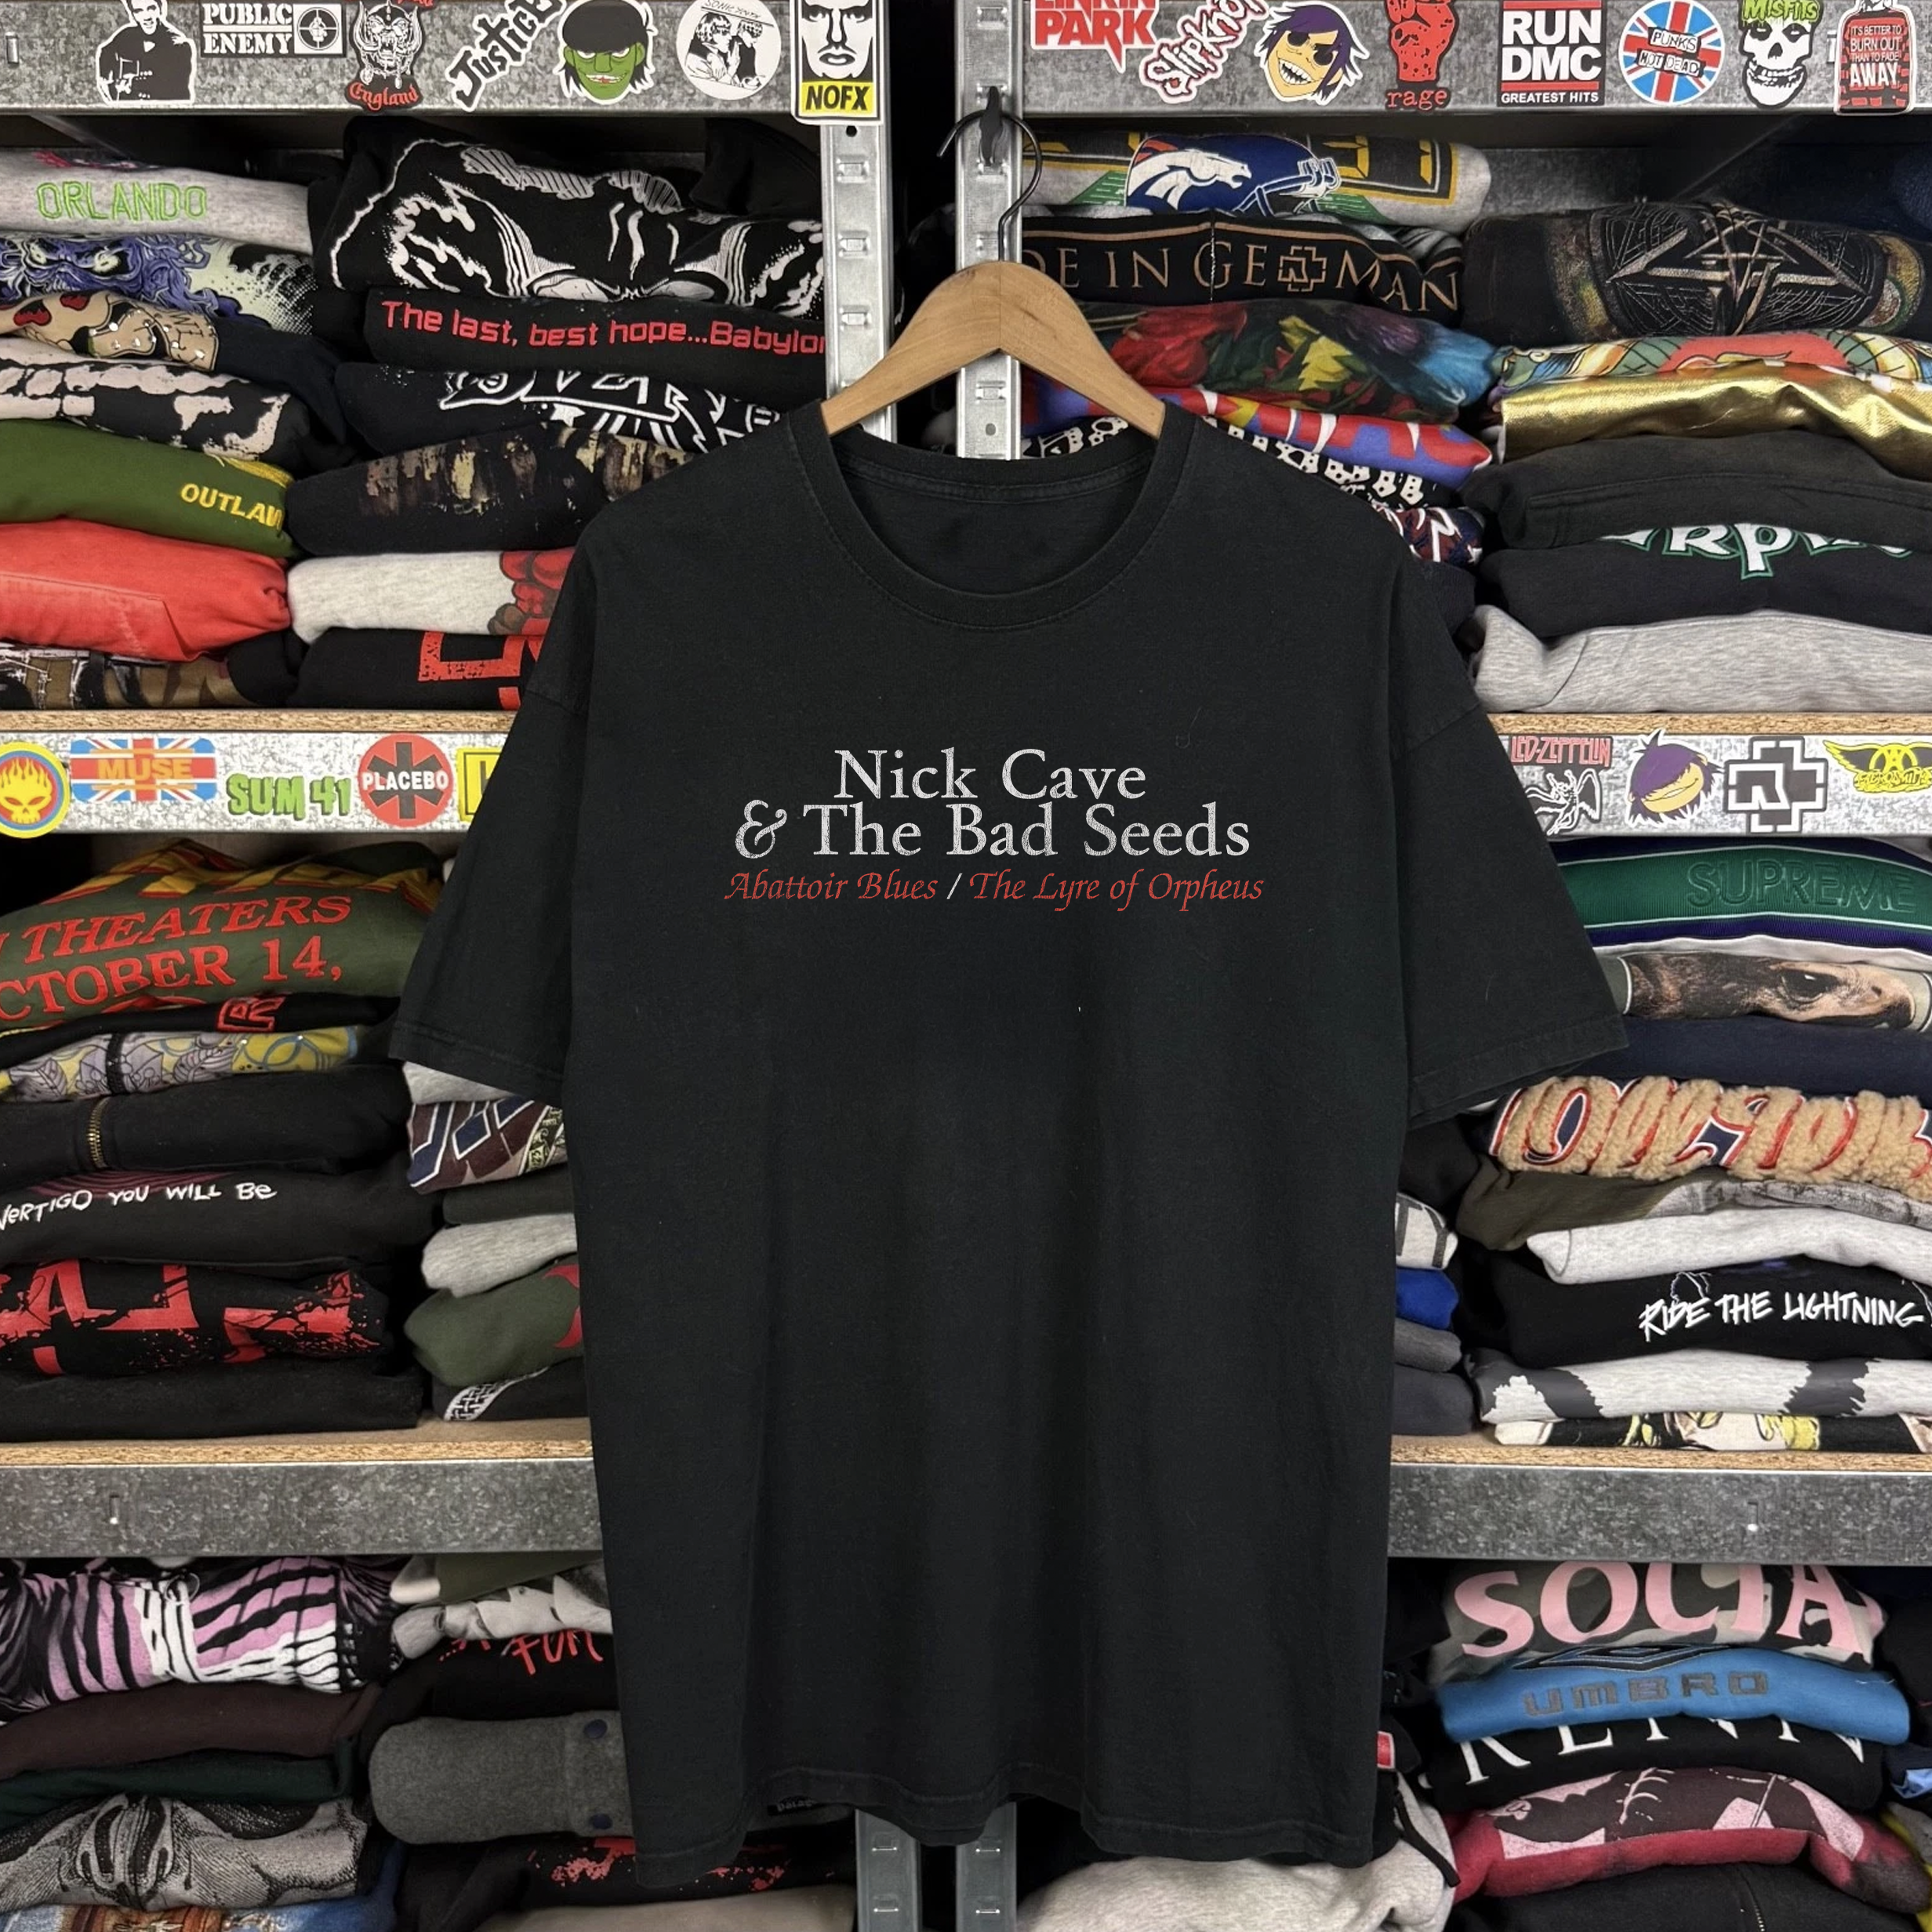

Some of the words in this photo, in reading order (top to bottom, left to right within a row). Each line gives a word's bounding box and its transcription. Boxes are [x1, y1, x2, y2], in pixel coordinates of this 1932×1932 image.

[202, 3, 292, 24] PUBLIC
[1503, 10, 1601, 45] RUN
[203, 33, 292, 53] ENEMY
[1035, 10, 1156, 66] PARK
[1651, 30, 1698, 52] PUNKS
[1850, 37, 1878, 52] BURN
[1880, 36, 1901, 51] OUT
[1864, 25, 1891, 35] BETTER
[1892, 25, 1902, 35] TO
[1502, 46, 1601, 81] DMC
[1665, 55, 1701, 76] DEAD
[1850, 51, 1869, 62] THAN
[1871, 51, 1880, 62] TO
[1882, 51, 1899, 61] FADE
[1850, 62, 1898, 87] AWAY
[348, 82, 419, 111] England
[805, 85, 870, 111] NOFX
[1387, 89, 1447, 111] rage
[1502, 92, 1564, 104] GREATEST
[1570, 92, 1599, 103] HITS
[37, 181, 206, 220] ORLANDO
[1106, 248, 1169, 289] IN
[382, 301, 441, 332] The
[452, 309, 518, 347] last,
[529, 321, 598, 347] best
[97, 757, 193, 782] MUSE
[362, 769, 449, 792] PLACEBO
[833, 746, 979, 799] Nick
[1002, 748, 1146, 799] Cave
[227, 772, 306, 820] SUM
[310, 775, 351, 816] 41
[735, 799, 787, 859] &
[803, 801, 921, 856] The
[946, 801, 1058, 856] Bad
[1084, 801, 1250, 856] Seeds
[724, 869, 848, 899] Abattoir
[857, 869, 939, 899] Blues
[969, 869, 1026, 899] The
[1033, 873, 1100, 911] Lyre
[1109, 869, 1145, 911] of
[1148, 869, 1264, 911] Orpheus
[1687, 859, 1916, 913] SUPREME
[22, 896, 351, 964] THEATERS
[262, 935, 342, 982] 14,
[165, 1183, 222, 1201] WILL
[1639, 1298, 1711, 1342] RIDE
[1714, 1291, 1774, 1324] THE
[1783, 1291, 1924, 1327] LIGHTNING
[1523, 1671, 1769, 1717] UMBRO
